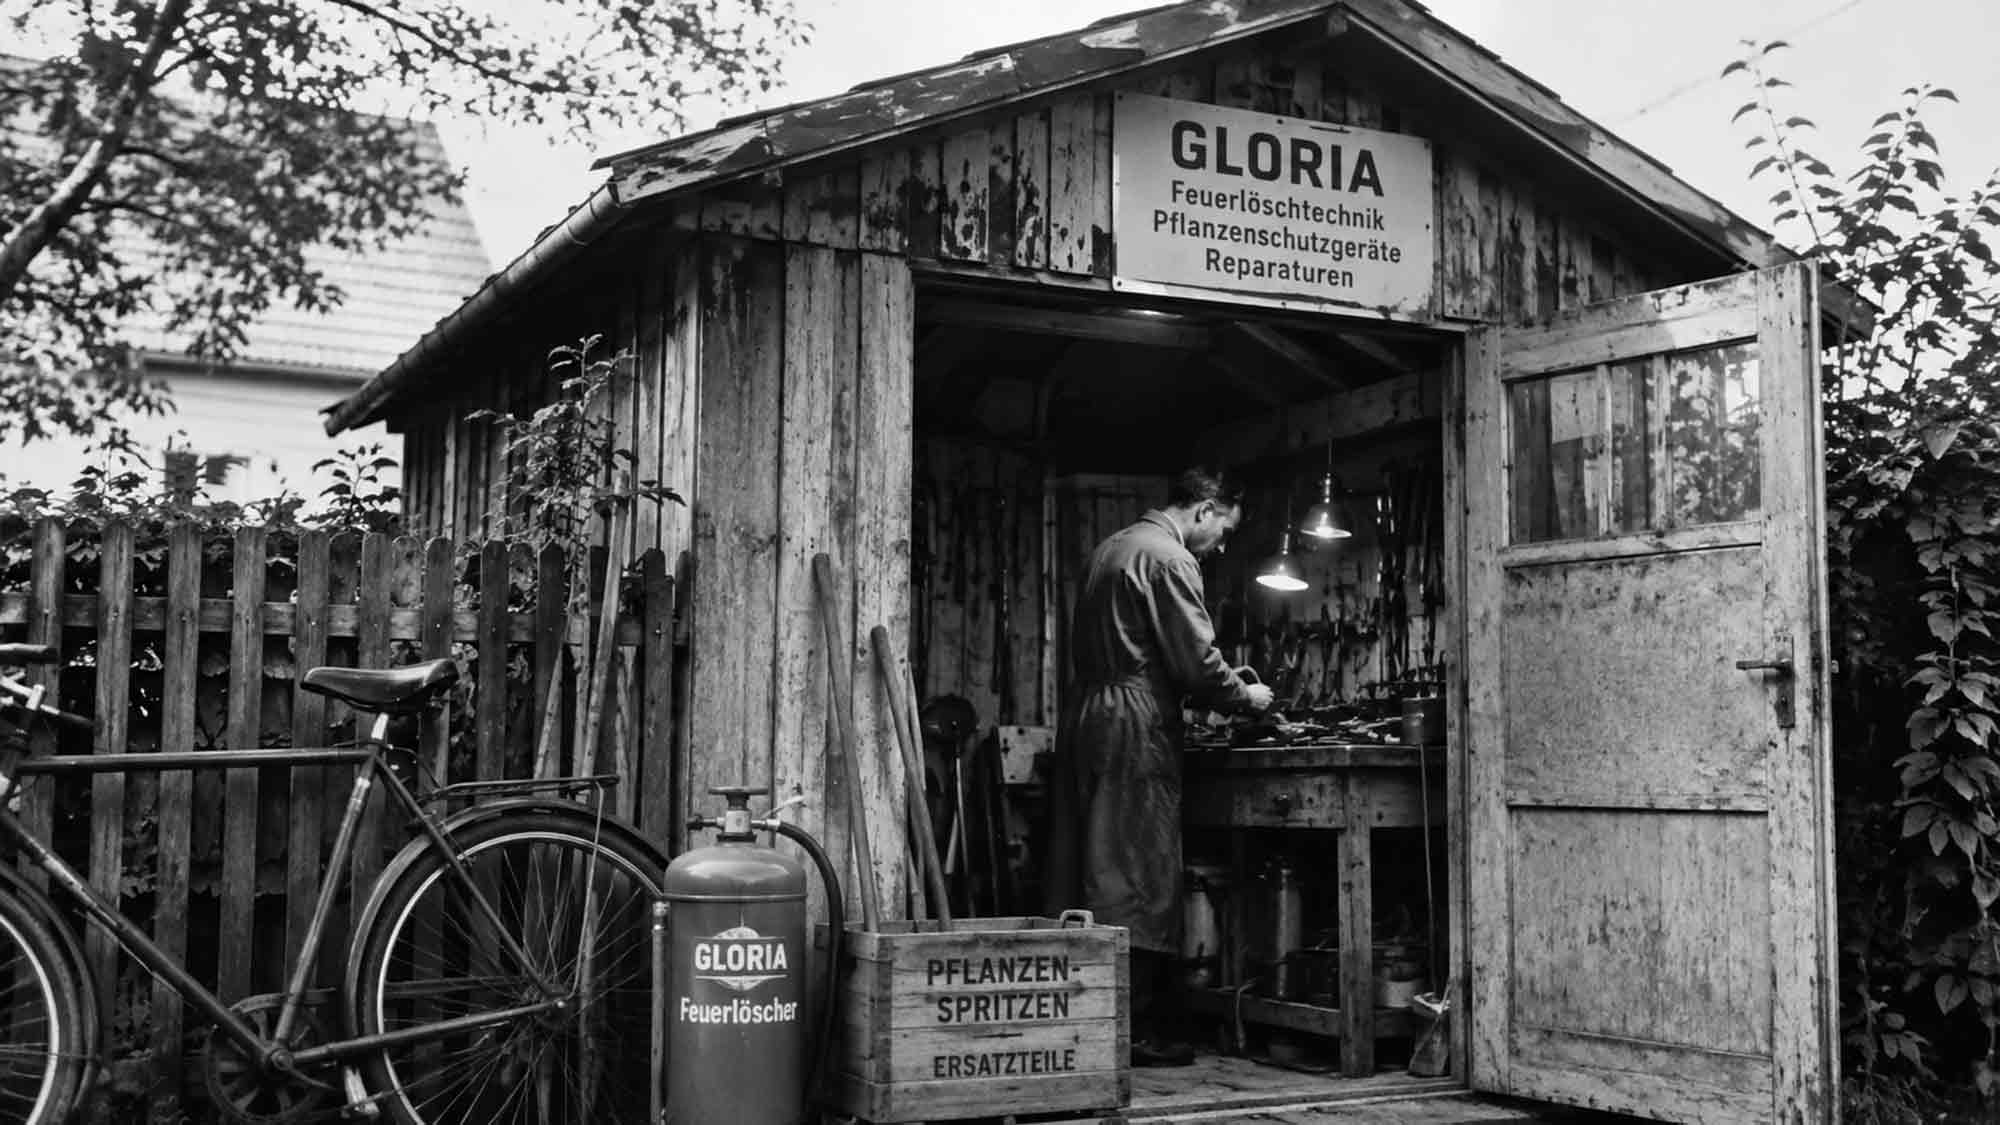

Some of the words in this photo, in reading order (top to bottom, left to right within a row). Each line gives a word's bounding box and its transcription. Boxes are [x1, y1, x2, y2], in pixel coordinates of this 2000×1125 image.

[1171, 119, 1384, 197] GLORIA
[1171, 180, 1384, 230] Feuerlöschtechnik
[1154, 210, 1401, 263] Pflanzenschutzgeräte
[1206, 248, 1353, 288] Reparaturen
[695, 943, 787, 971] GLORIA
[928, 956, 1080, 985] PFLANZEN-
[680, 997, 797, 1024] Feuerlöscher
[937, 992, 1069, 1023] SPRITZEN
[934, 1049, 1076, 1078] ERSATZTEILE
